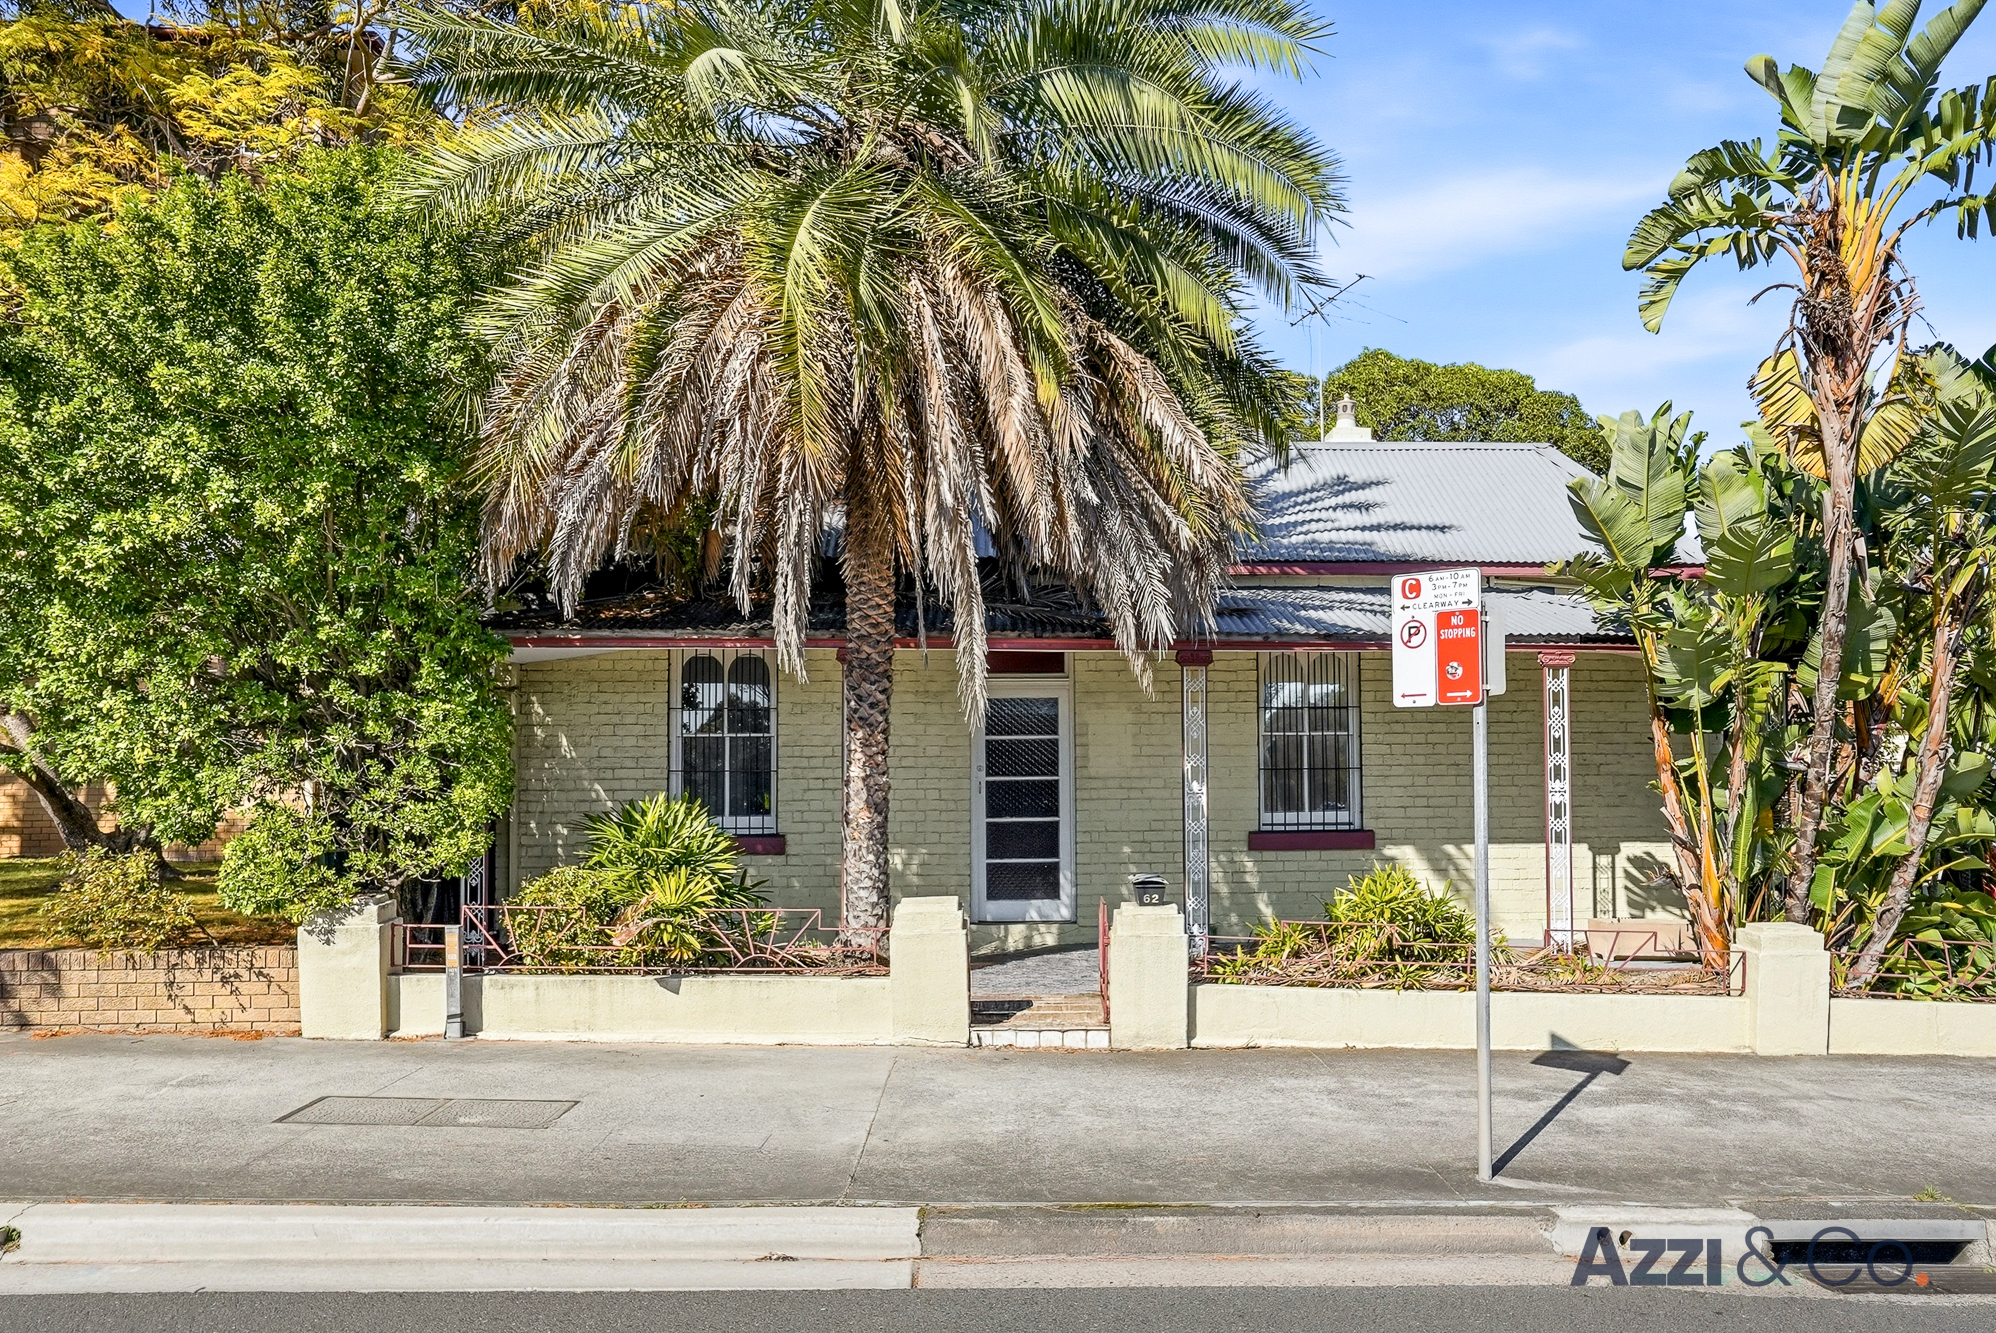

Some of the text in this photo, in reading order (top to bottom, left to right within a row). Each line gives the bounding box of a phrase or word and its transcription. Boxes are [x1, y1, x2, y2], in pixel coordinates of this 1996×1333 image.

[1405, 579, 1417, 598] C
[1412, 600, 1459, 610] CLEARWAY
[1450, 615, 1464, 626] NO
[1440, 627, 1476, 639] STOPPING
[1143, 894, 1159, 903] 62
